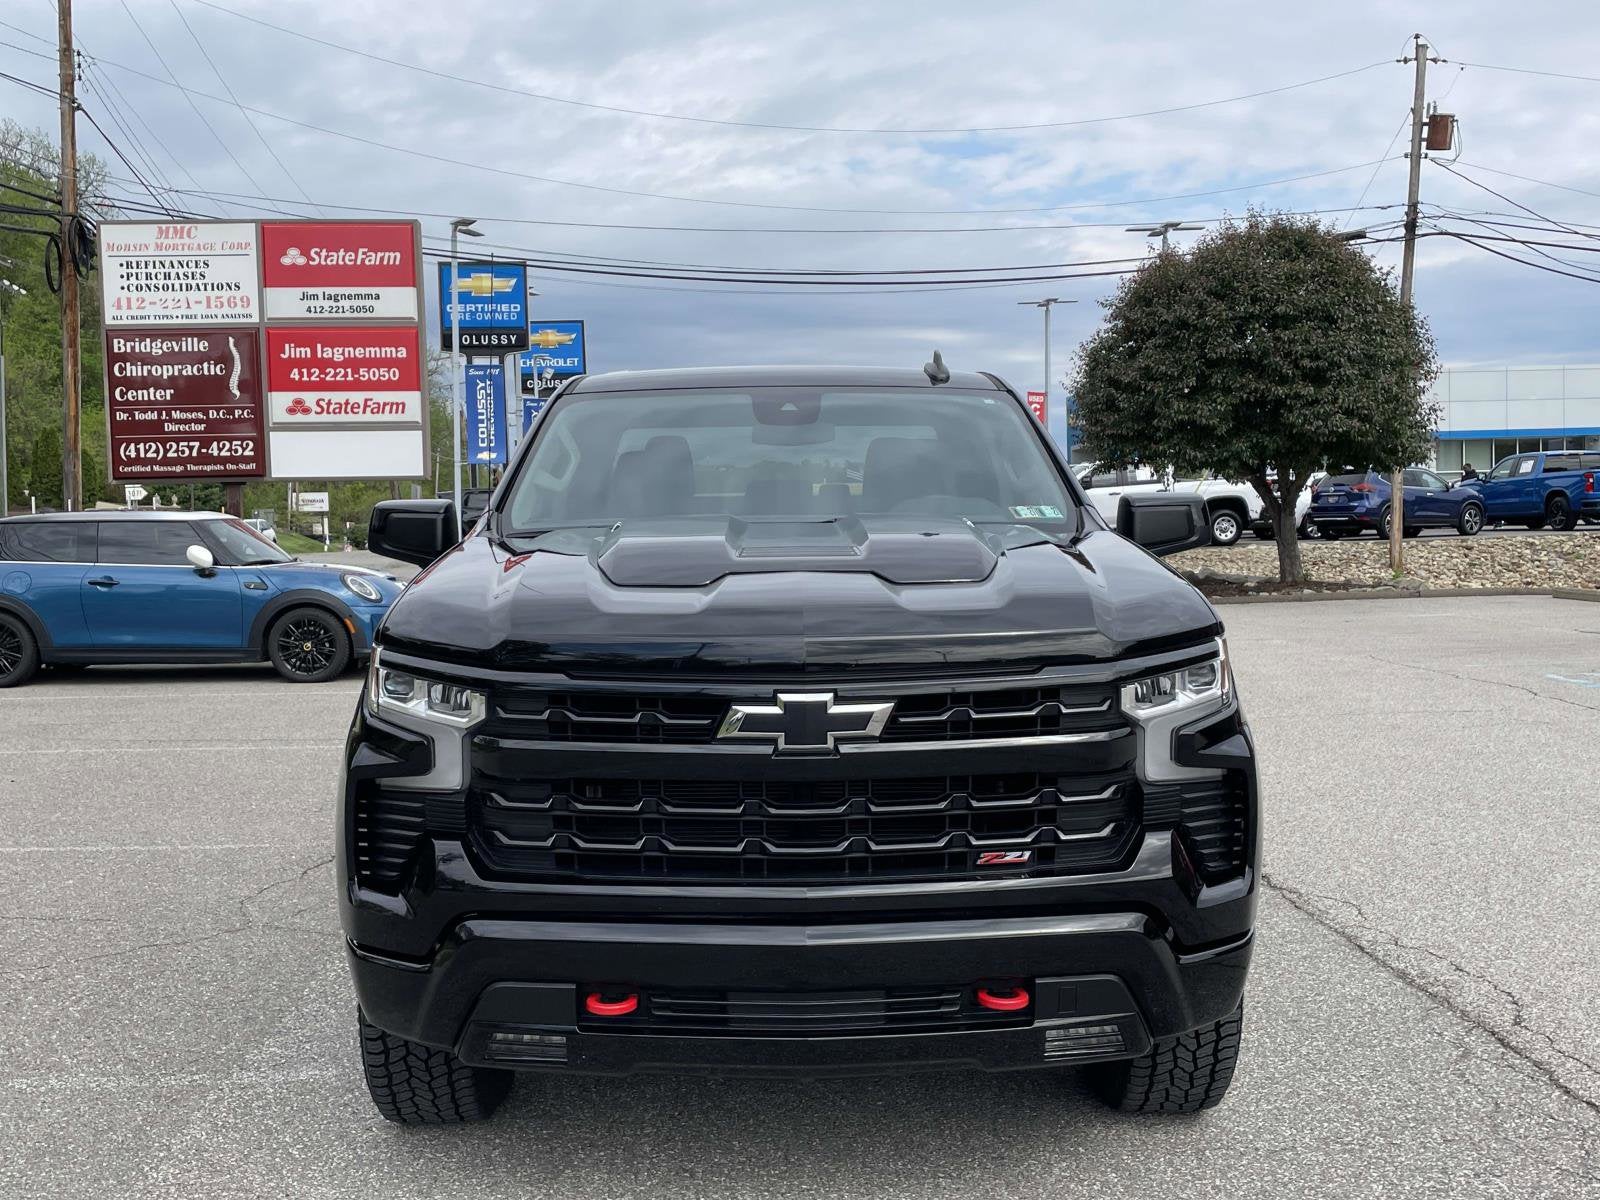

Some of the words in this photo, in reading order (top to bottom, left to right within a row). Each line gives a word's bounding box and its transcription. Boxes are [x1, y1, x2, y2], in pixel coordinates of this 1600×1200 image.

[155, 226, 198, 239] MMC
[154, 242, 216, 251] MORTGAGE
[125, 260, 210, 270] REFINANCES
[126, 271, 207, 281] PURCHASES
[126, 282, 241, 292] CONSOLIDATIONS
[300, 292, 318, 301] Jim
[322, 292, 380, 302] Iagnemma
[112, 296, 250, 310] 412-221-1569
[446, 304, 520, 312] CERTIFIED
[306, 305, 374, 314] 412-221-5050
[462, 335, 518, 345] OLUSSY
[113, 338, 208, 355] Bridgeville
[280, 344, 311, 358] Jim
[316, 344, 407, 362] Iagnemma
[520, 358, 579, 367] CHEVROLET
[113, 361, 226, 379] Chiropractic
[290, 368, 400, 382] 412-221-5050
[114, 386, 174, 402] Center
[116, 412, 132, 420] Dr.
[134, 411, 158, 420] Todd
[160, 410, 169, 420] J.
[172, 410, 206, 420] Moses,
[209, 410, 233, 420] D.C.,
[234, 409, 254, 418] P.C.
[476, 379, 488, 447] COLUSSY
[164, 422, 206, 432] Director
[120, 442, 164, 461] (412)
[166, 440, 254, 458] 257-4252
[119, 464, 151, 472] Certified
[152, 464, 184, 472] Massage
[187, 463, 224, 472] Therapists
